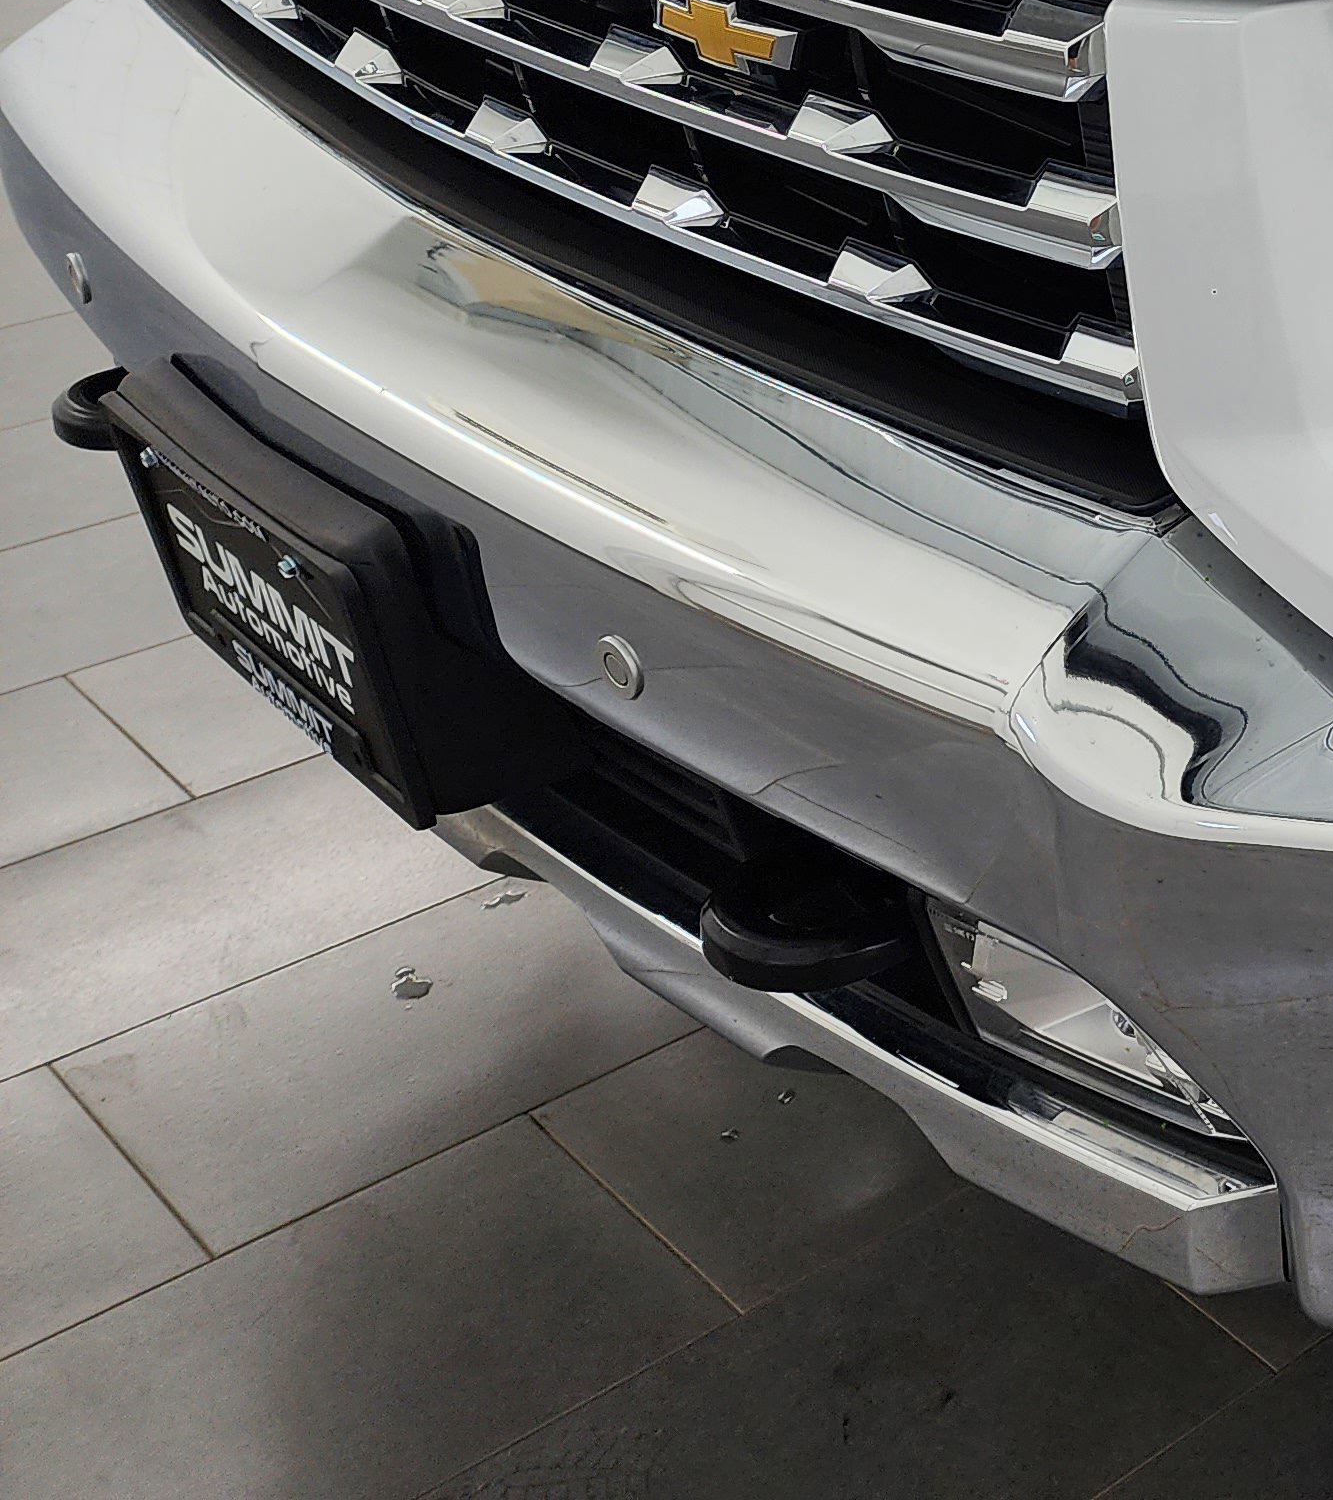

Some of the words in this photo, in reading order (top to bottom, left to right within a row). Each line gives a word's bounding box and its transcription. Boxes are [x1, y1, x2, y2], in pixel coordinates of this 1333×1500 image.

[166, 502, 354, 688] SUMMIT
[202, 565, 355, 716] Automotive
[231, 638, 334, 744] SUMMIT
